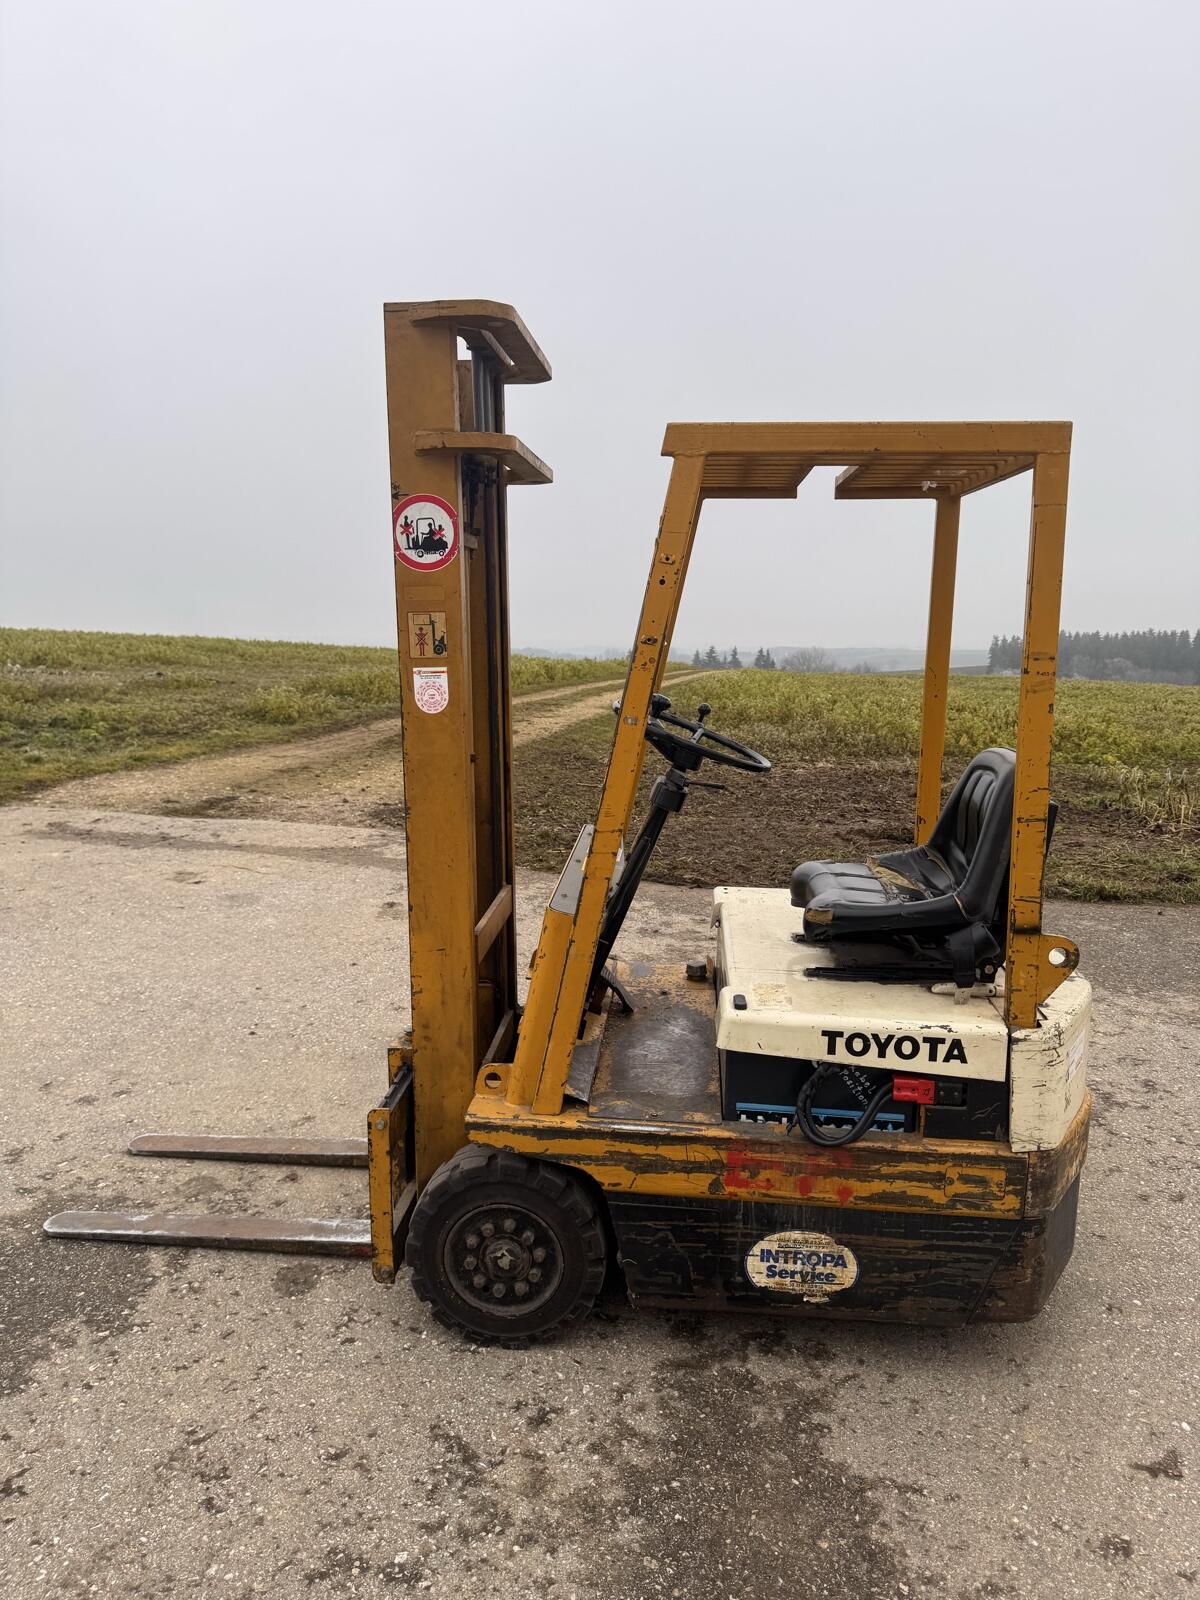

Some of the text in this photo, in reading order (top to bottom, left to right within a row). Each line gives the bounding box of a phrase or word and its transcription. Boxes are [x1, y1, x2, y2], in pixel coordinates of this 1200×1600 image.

[821, 1030, 968, 1064] TOYOTA
[760, 1248, 848, 1268] INTROPA
[766, 1264, 837, 1282] Service
